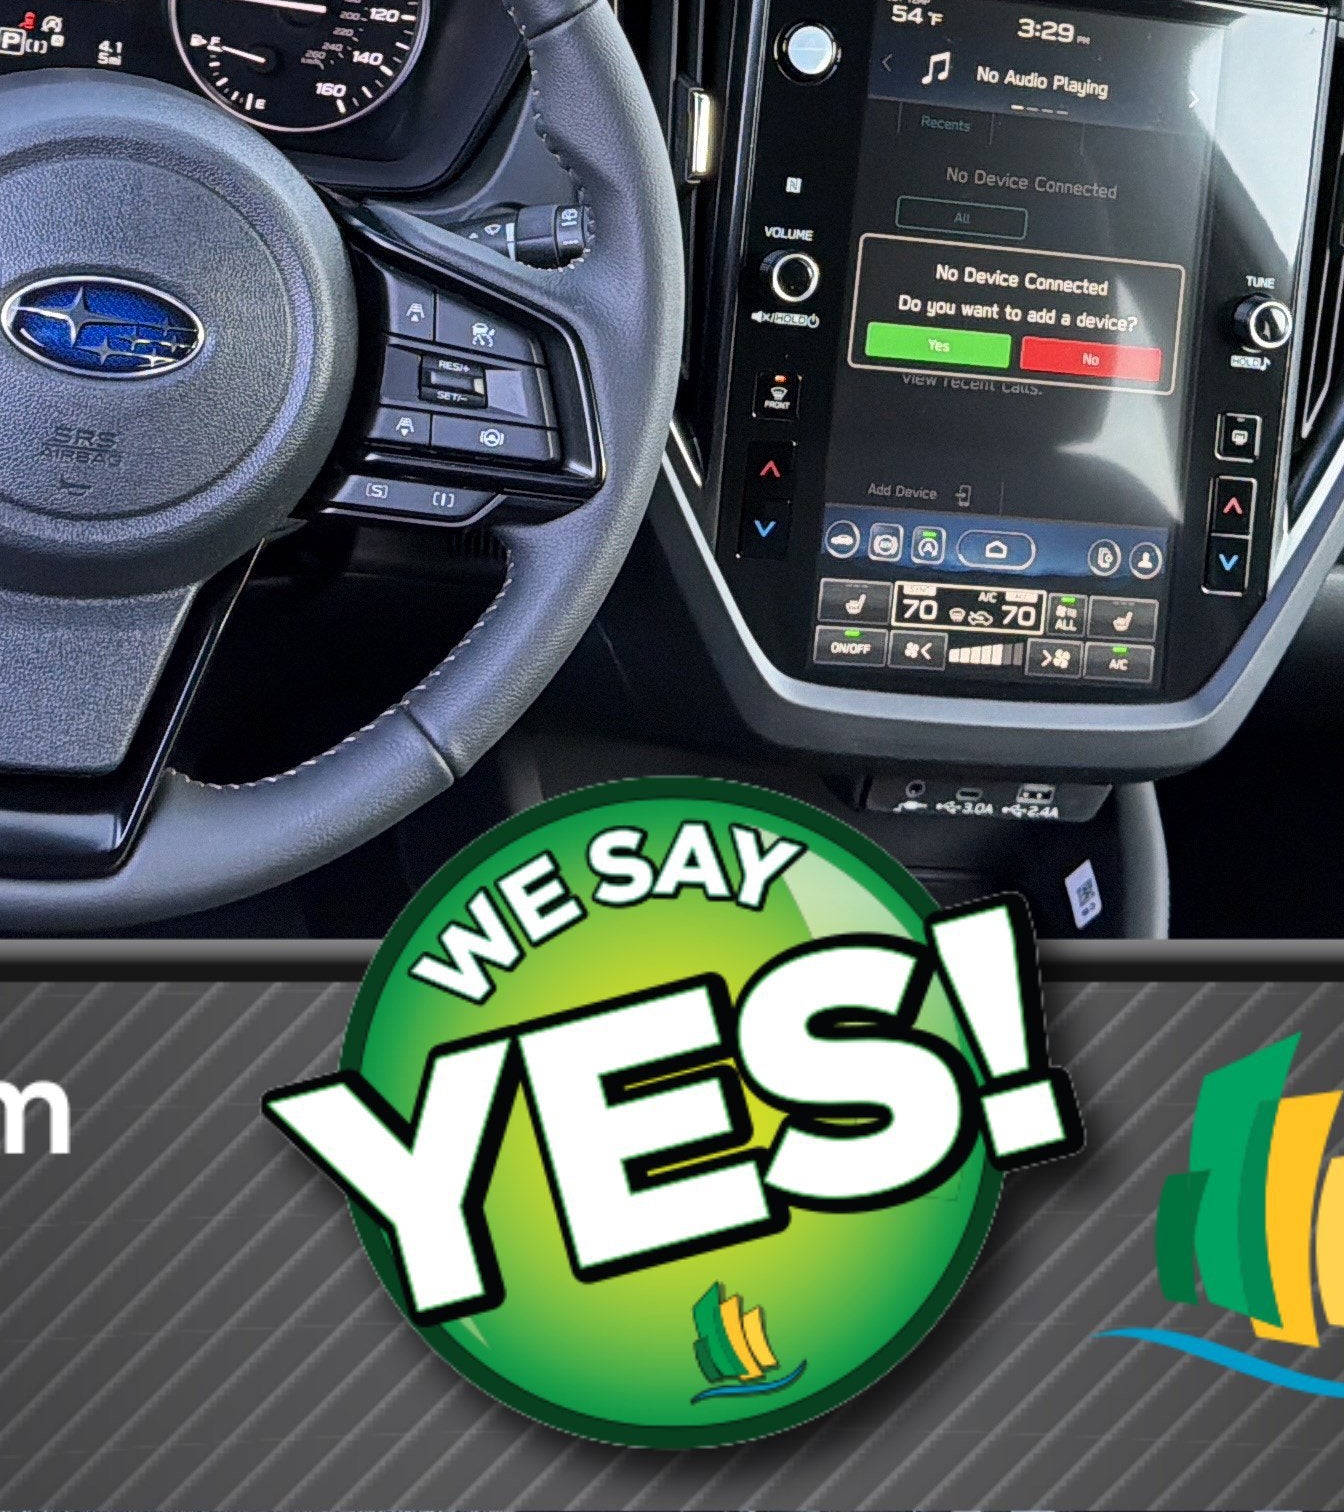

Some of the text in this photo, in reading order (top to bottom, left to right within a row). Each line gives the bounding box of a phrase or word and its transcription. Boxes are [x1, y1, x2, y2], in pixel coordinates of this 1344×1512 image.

[339, 10, 361, 21] 200
[369, 7, 400, 23] 120
[891, 4, 923, 25] 54
[1017, 17, 1075, 43] 3:29
[1, 31, 21, 49] P
[209, 36, 221, 47] F
[321, 42, 343, 52] 240
[352, 50, 384, 66] 140
[315, 82, 346, 98] 160
[976, 65, 1109, 100] No Audio Playing
[255, 99, 266, 110] E
[921, 115, 971, 132] Recents
[946, 166, 1118, 200] No Device Connected
[954, 212, 971, 225] All
[764, 225, 814, 242] VOLUME
[936, 264, 1109, 296] No Device Connected
[1246, 275, 1276, 289] TUNE
[898, 294, 1139, 333] Do you want to add a device?
[928, 338, 950, 353] Yes
[1082, 352, 1100, 367] No
[763, 399, 790, 410] FRONT
[55, 426, 117, 448] SRS
[867, 482, 938, 500] Add Device
[978, 592, 999, 603] A/C
[903, 599, 938, 620] 70
[1001, 605, 1037, 627] 70
[1055, 619, 1078, 632] ALL
[830, 641, 872, 655] ON/OFF
[1108, 658, 1129, 671] A/C
[961, 802, 994, 815] 3.0A
[1027, 806, 1059, 819] 2.4A
